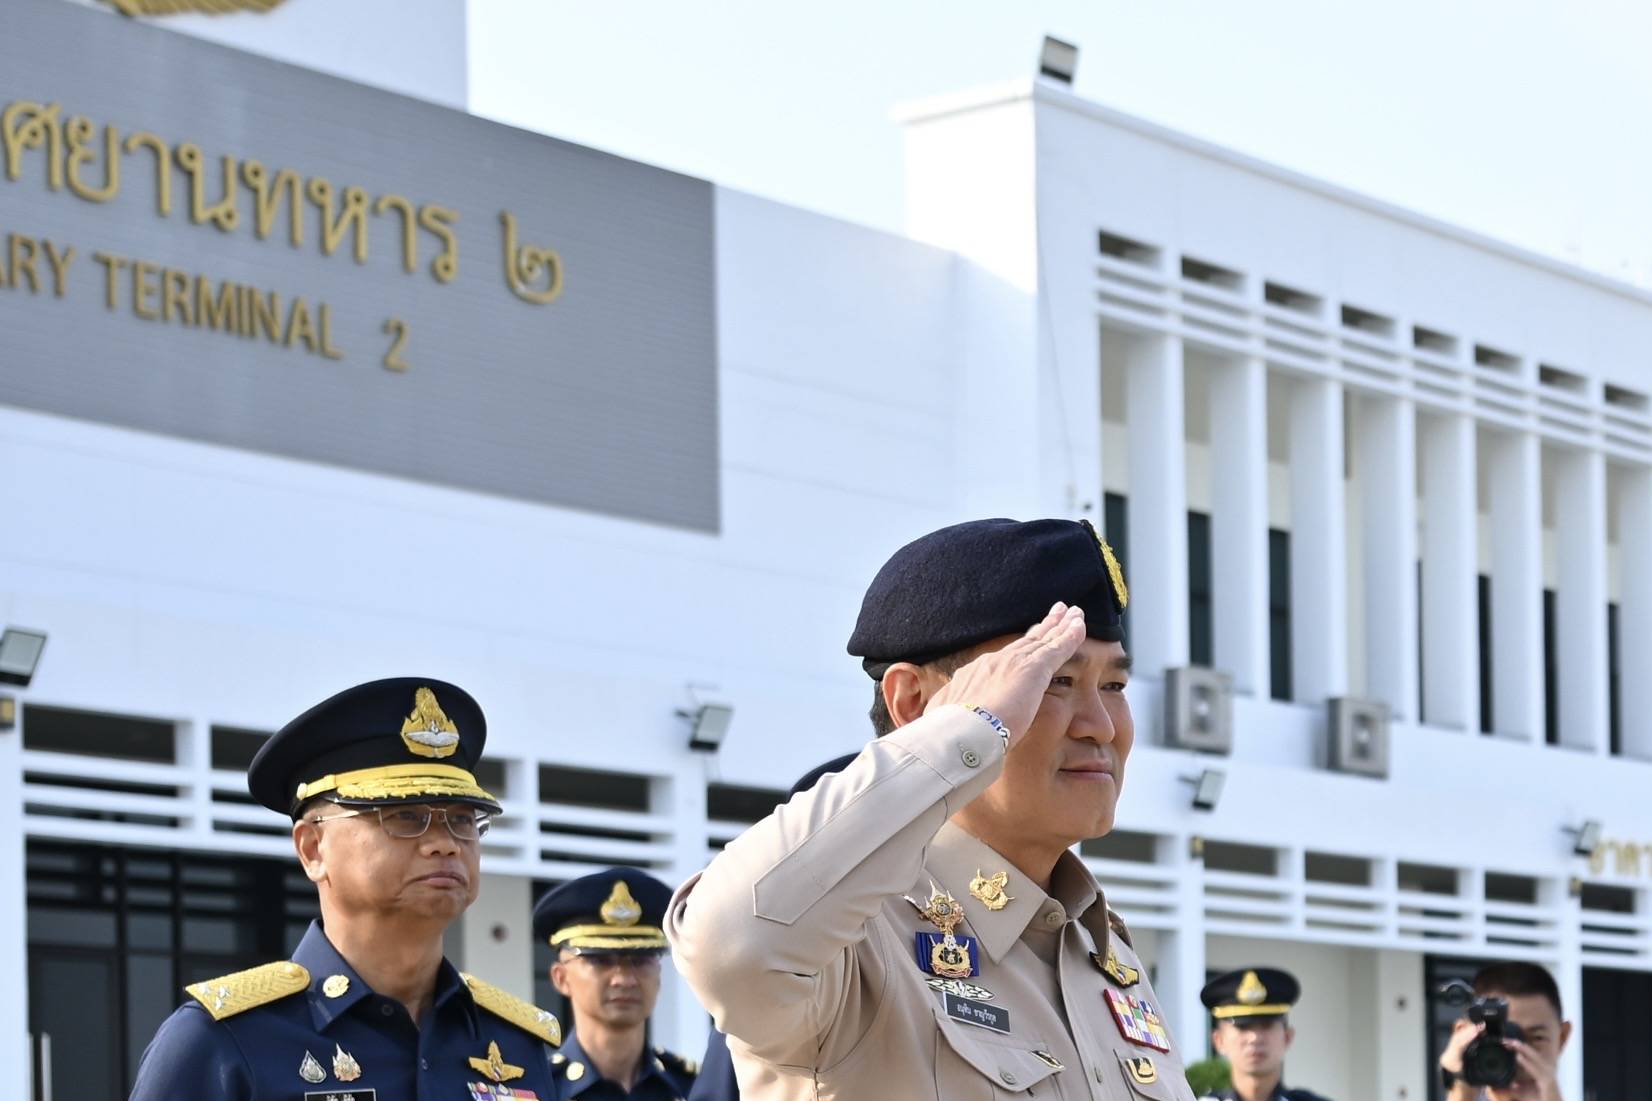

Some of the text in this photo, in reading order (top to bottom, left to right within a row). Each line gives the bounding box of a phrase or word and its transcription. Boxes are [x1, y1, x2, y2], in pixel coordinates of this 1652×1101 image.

[2, 102, 564, 305] ศยานทหาร ๒
[0, 231, 412, 373] RY TERMINAL 2
